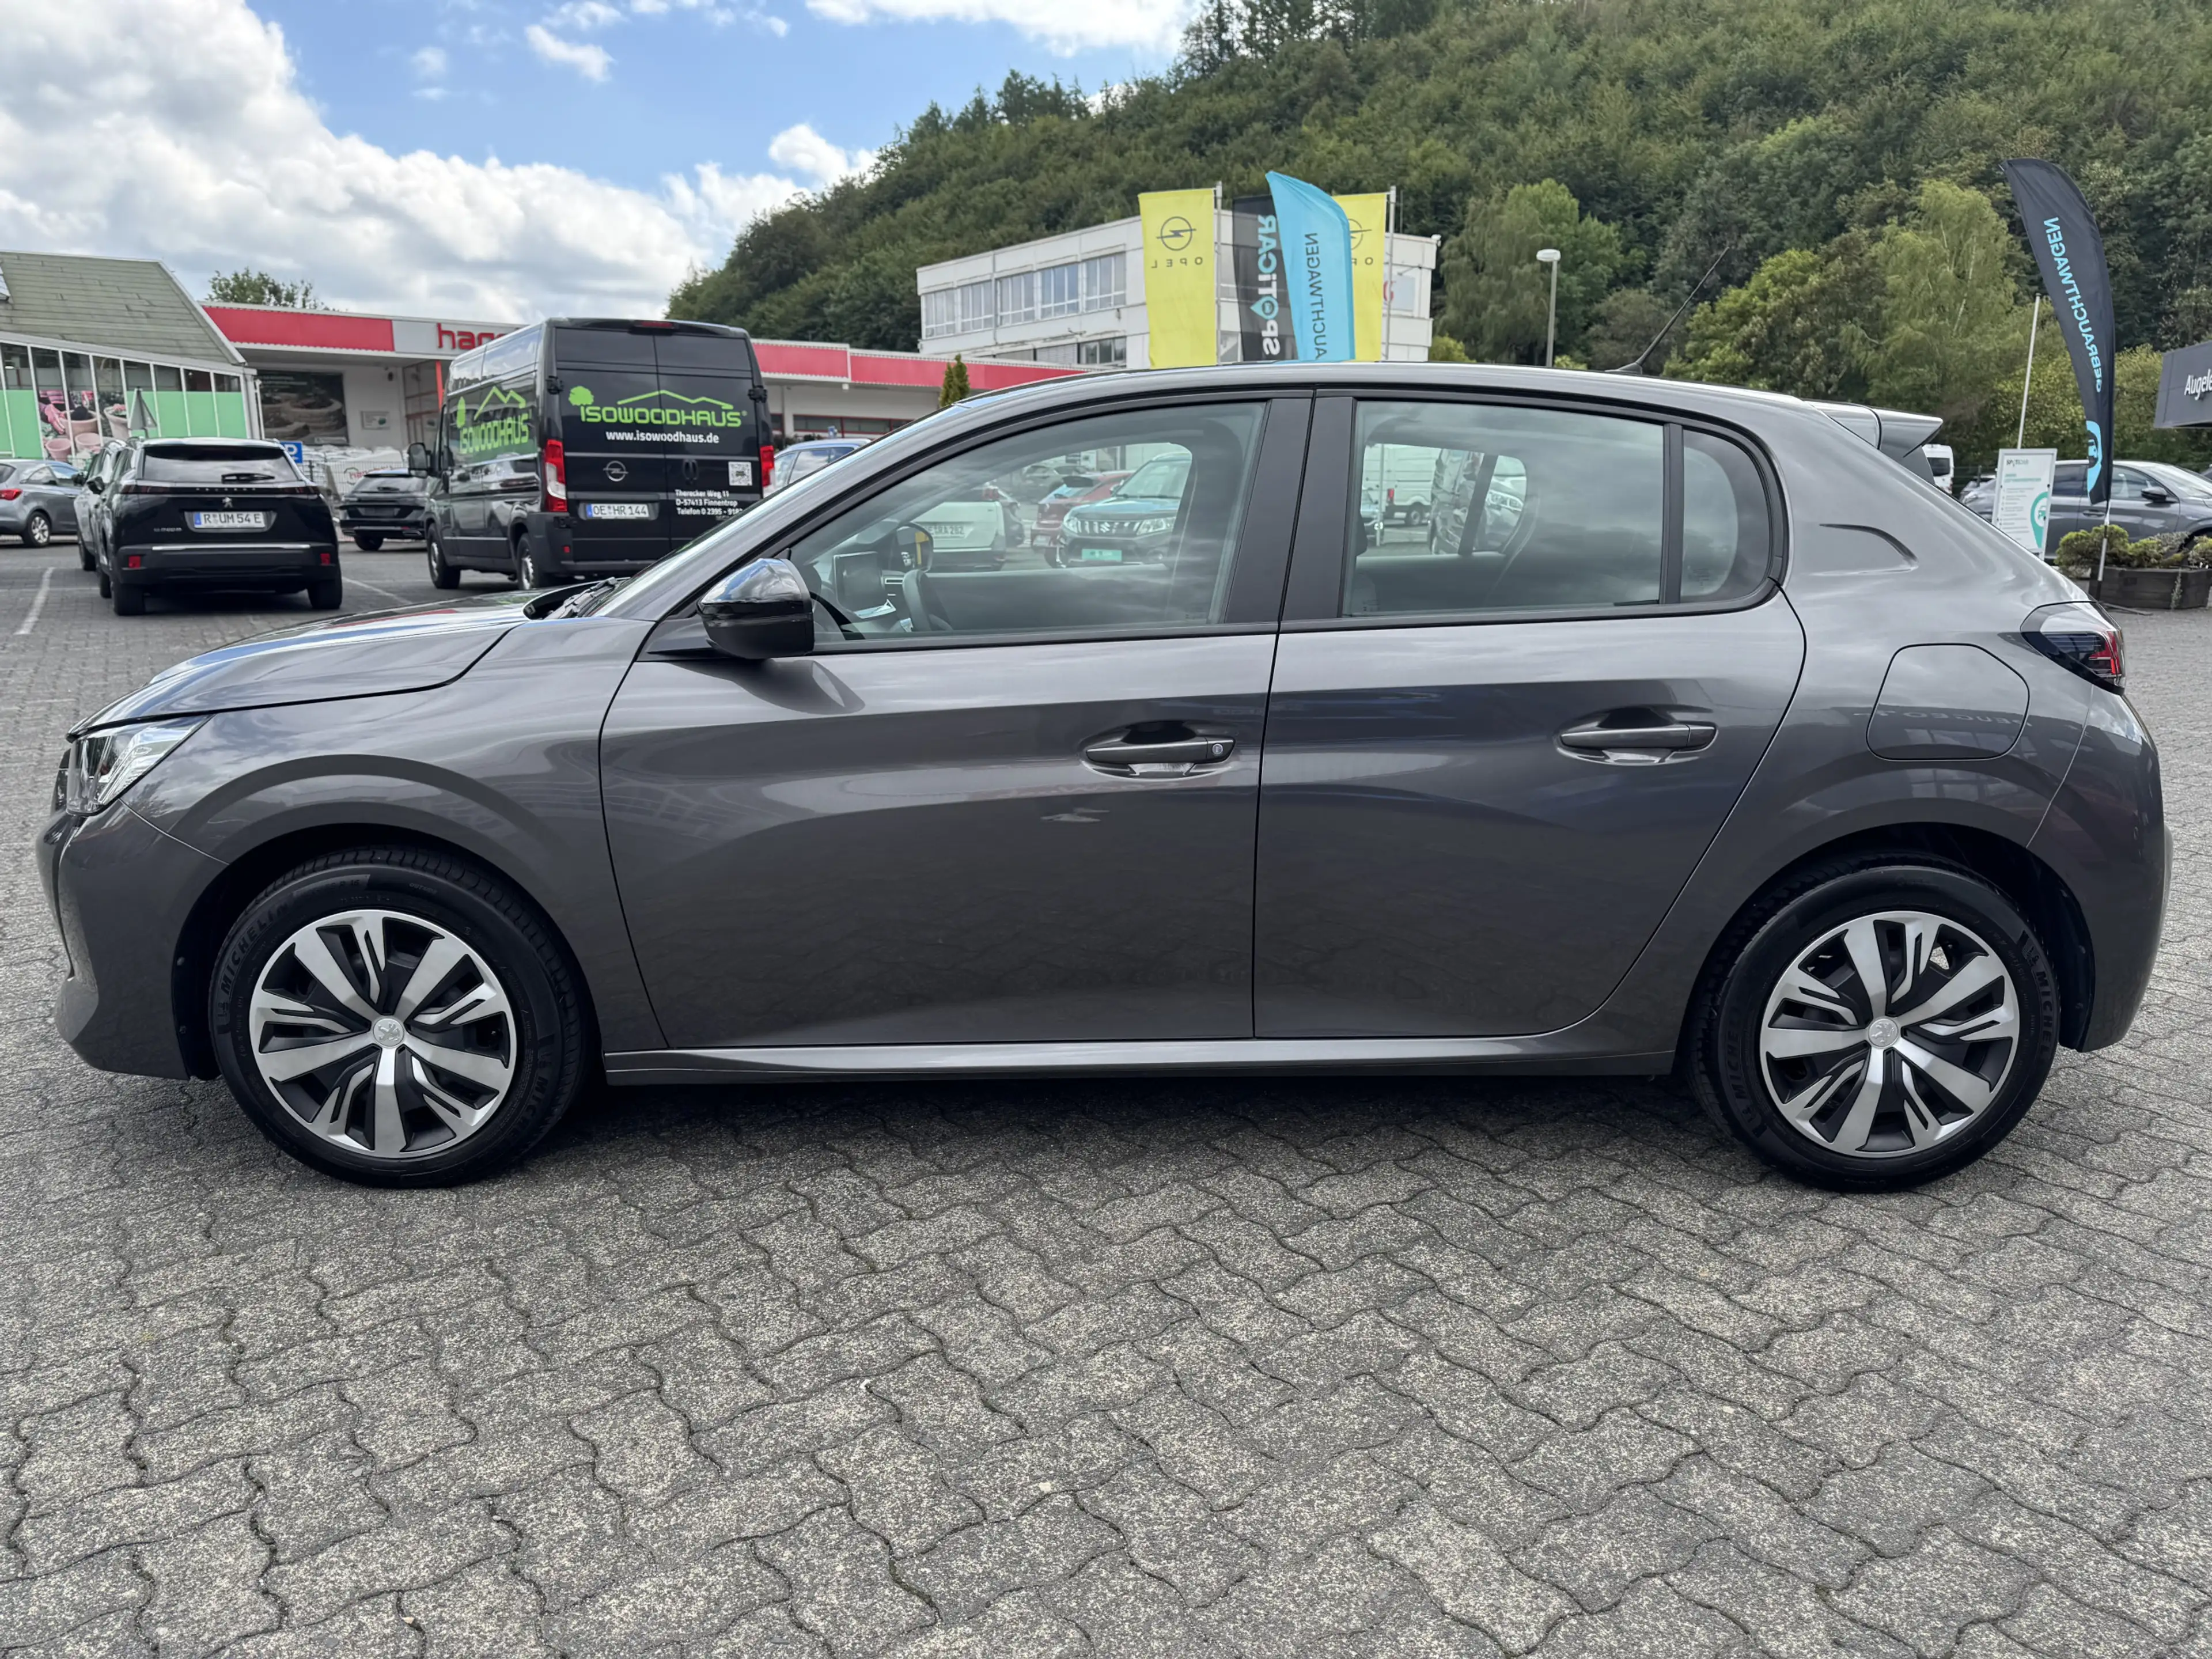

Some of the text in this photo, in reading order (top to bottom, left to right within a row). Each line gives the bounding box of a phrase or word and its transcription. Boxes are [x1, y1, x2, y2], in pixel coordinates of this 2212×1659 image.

[580, 406, 742, 427] ISOWOODHAUS
[605, 430, 719, 444] www.isowoodhaus.de
[707, 490, 722, 499] Weg
[704, 499, 738, 507] Finnentrop
[593, 505, 647, 516] OE HR 144
